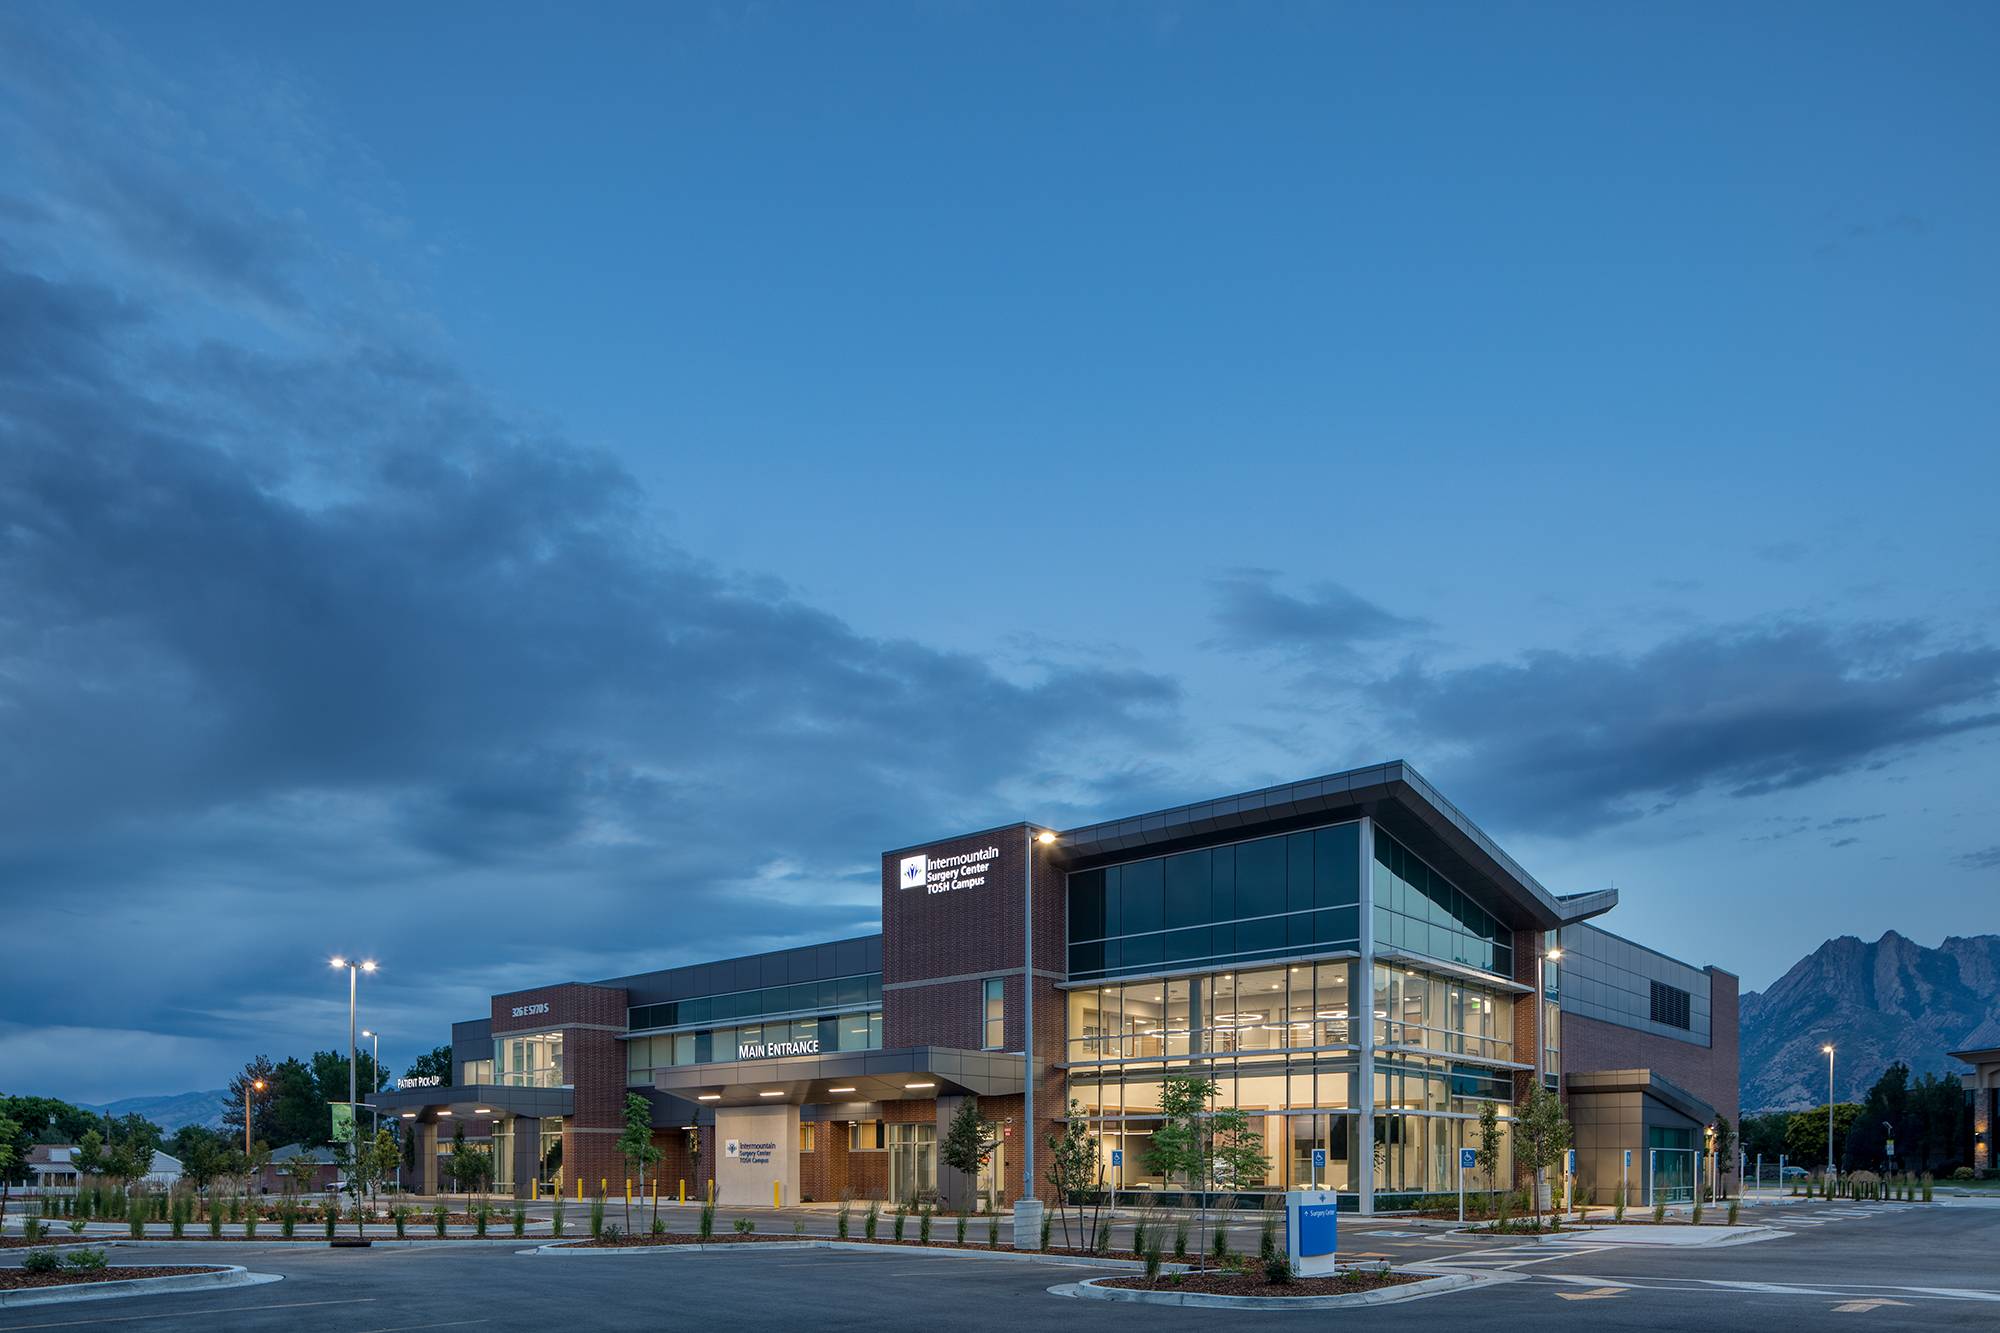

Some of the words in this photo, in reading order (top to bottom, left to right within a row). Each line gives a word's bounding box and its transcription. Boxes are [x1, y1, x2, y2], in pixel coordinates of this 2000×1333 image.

[927, 846, 999, 871] Intermountain
[927, 868, 959, 882] Surgery
[960, 863, 989, 876] Center
[927, 882, 950, 894] TOSH
[951, 876, 985, 890] Campus
[524, 1006, 528, 1016] E
[544, 1002, 549, 1012] S
[739, 1045, 765, 1058] MAIN
[767, 1040, 819, 1056] ENTRANCE
[398, 1078, 418, 1088] PATIENT
[418, 1076, 440, 1087] PICK-UP
[1310, 1210, 1325, 1218] Surgery
